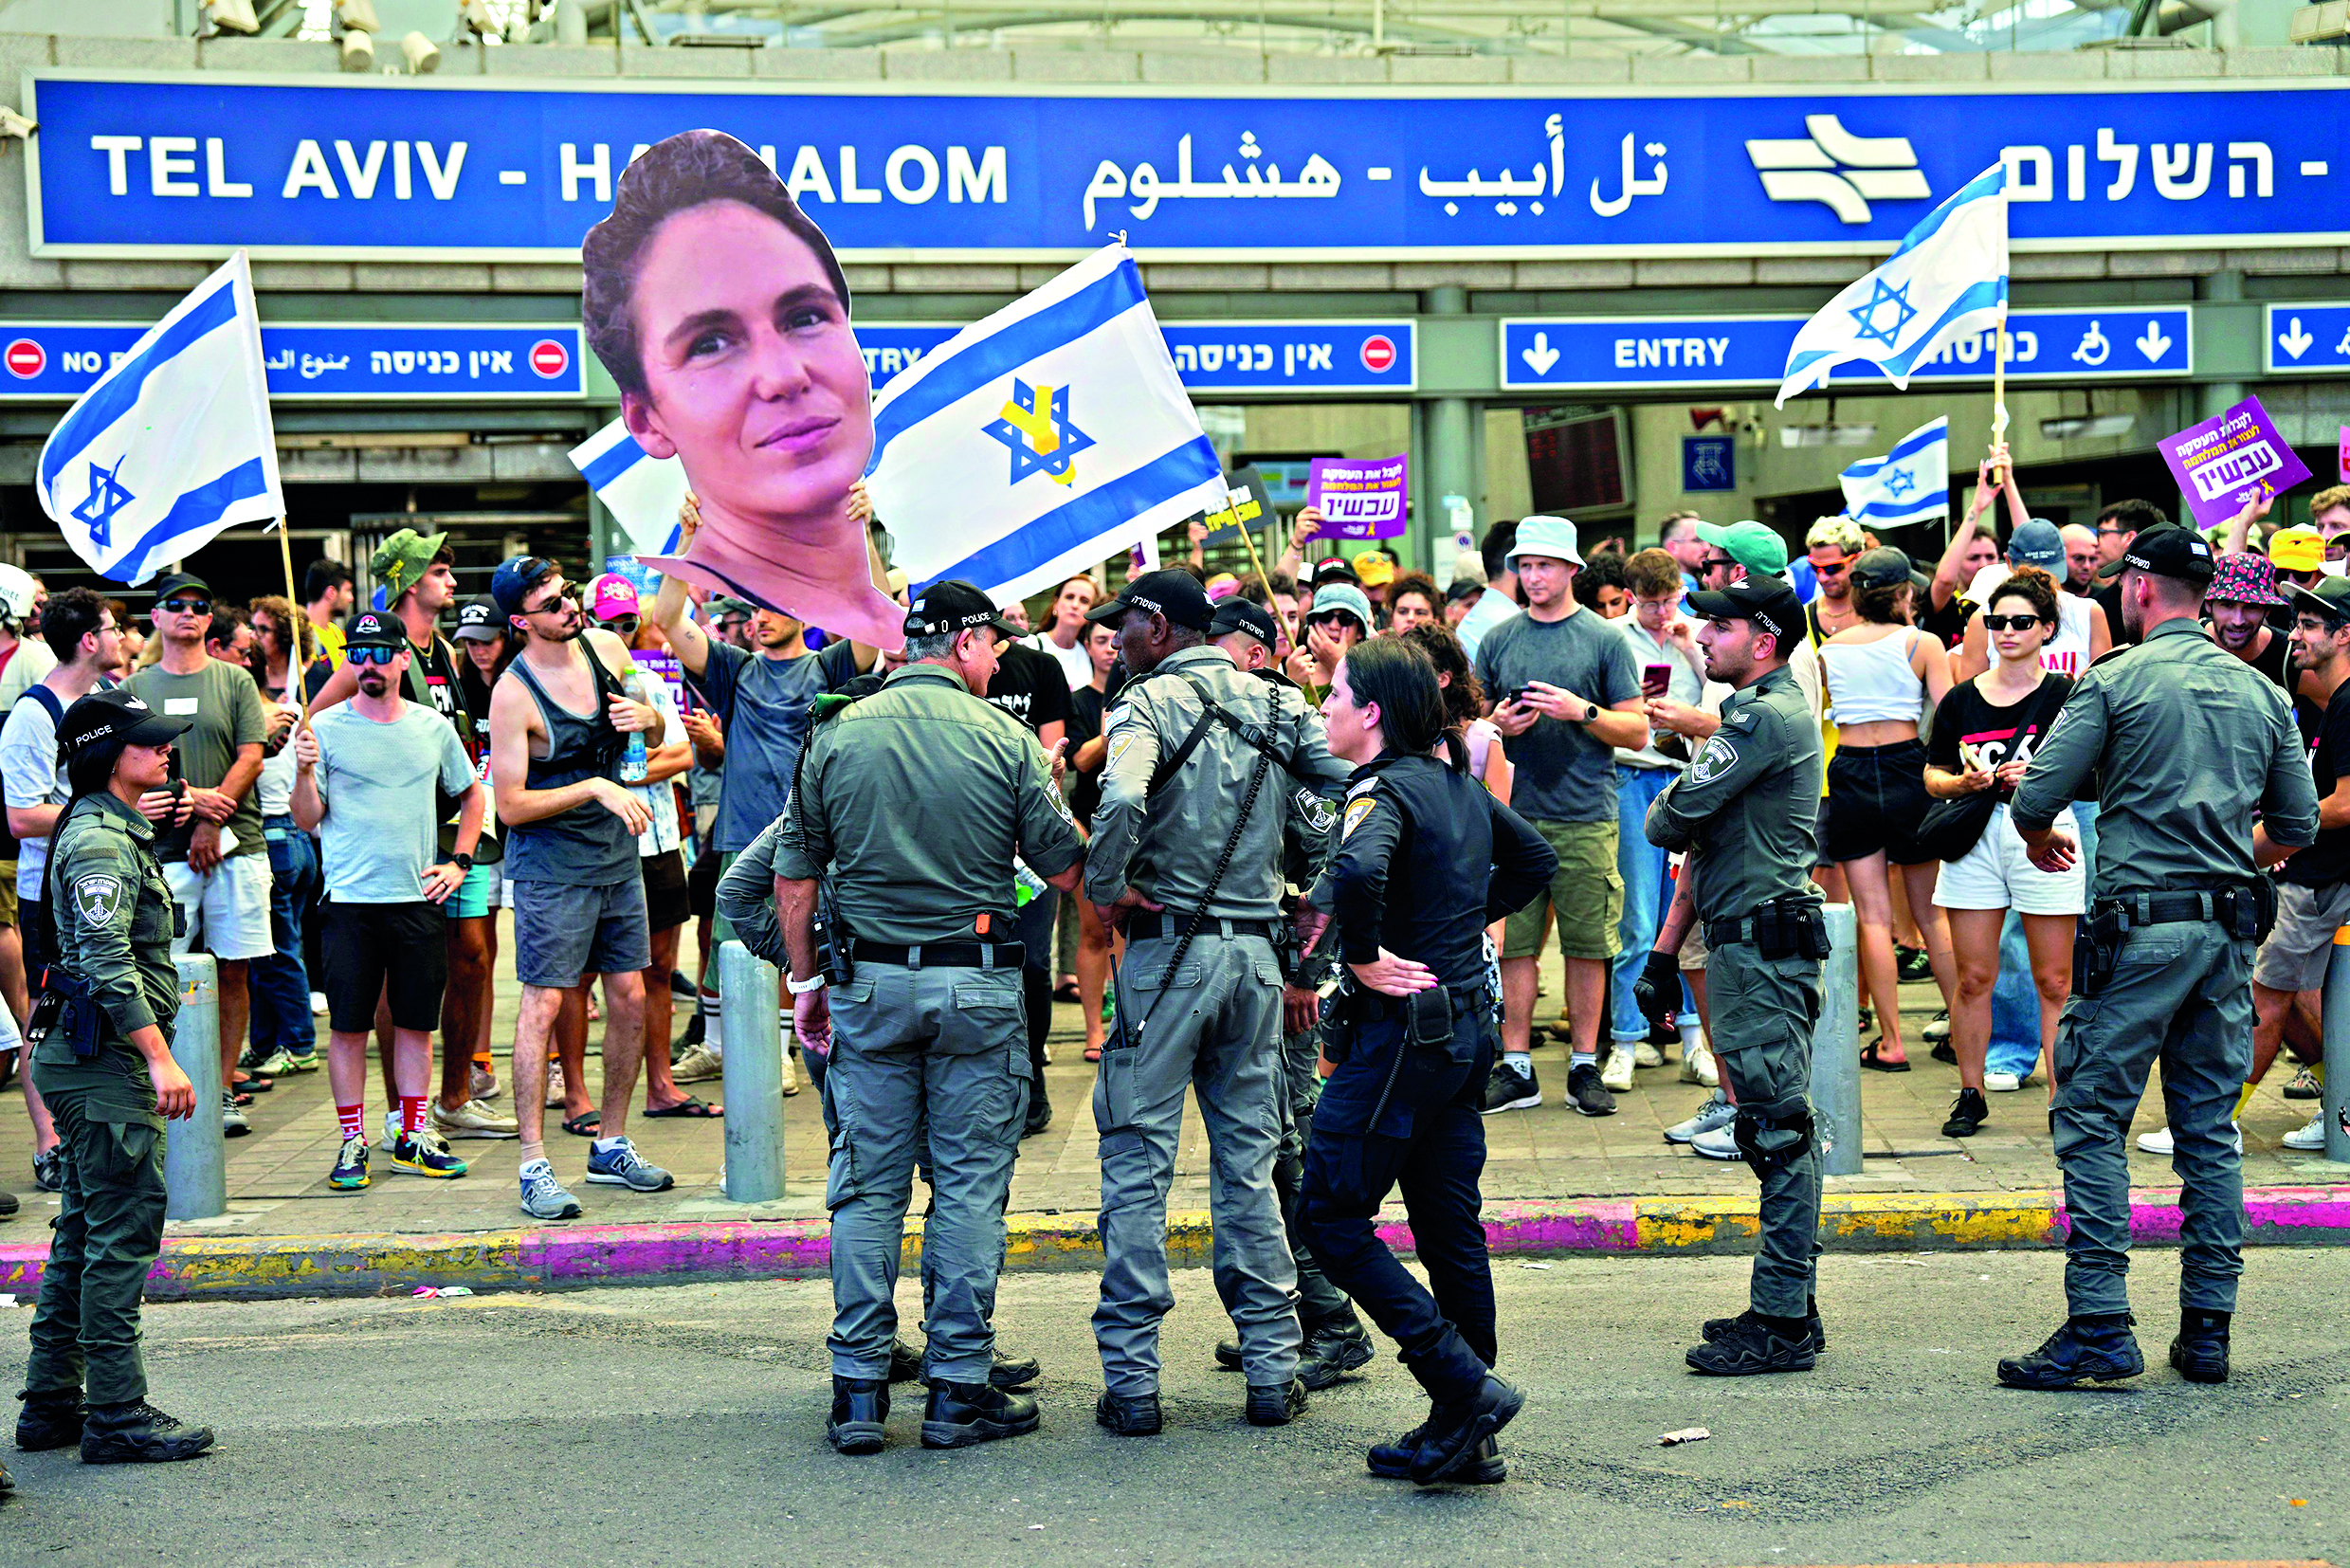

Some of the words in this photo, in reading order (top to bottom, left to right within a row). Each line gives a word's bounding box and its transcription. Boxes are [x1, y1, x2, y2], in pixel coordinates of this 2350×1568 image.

[91, 136, 253, 197] TEL
[282, 139, 467, 200] AVIV
[500, 171, 527, 185] -
[1419, 114, 1565, 217] أبيب
[1591, 133, 1668, 217] تل
[2004, 128, 2273, 202] השלום
[1084, 131, 1341, 232] هشلوم
[63, 351, 102, 374] NO
[371, 351, 461, 374] כניסה
[470, 351, 514, 379] אין
[1175, 345, 1274, 372] כניסה
[1285, 344, 1333, 377] אין
[1614, 337, 1730, 368] ENTRY
[2229, 411, 2252, 431] לקבל
[2236, 424, 2260, 443] לעצור
[2176, 430, 2218, 457] העסקה
[2182, 443, 2228, 469] המלחמה
[1321, 467, 1363, 482] העסקה
[1364, 469, 1381, 480] את
[2197, 447, 2273, 492] עכשיו
[1327, 498, 1394, 516] עכשיו
[2124, 554, 2151, 570] משטרה
[1131, 594, 1162, 613] משטרה
[961, 611, 992, 627] POLICE
[1238, 618, 1266, 639] משטרה
[1755, 611, 1783, 637] משטרה
[76, 724, 113, 748] POLICE
